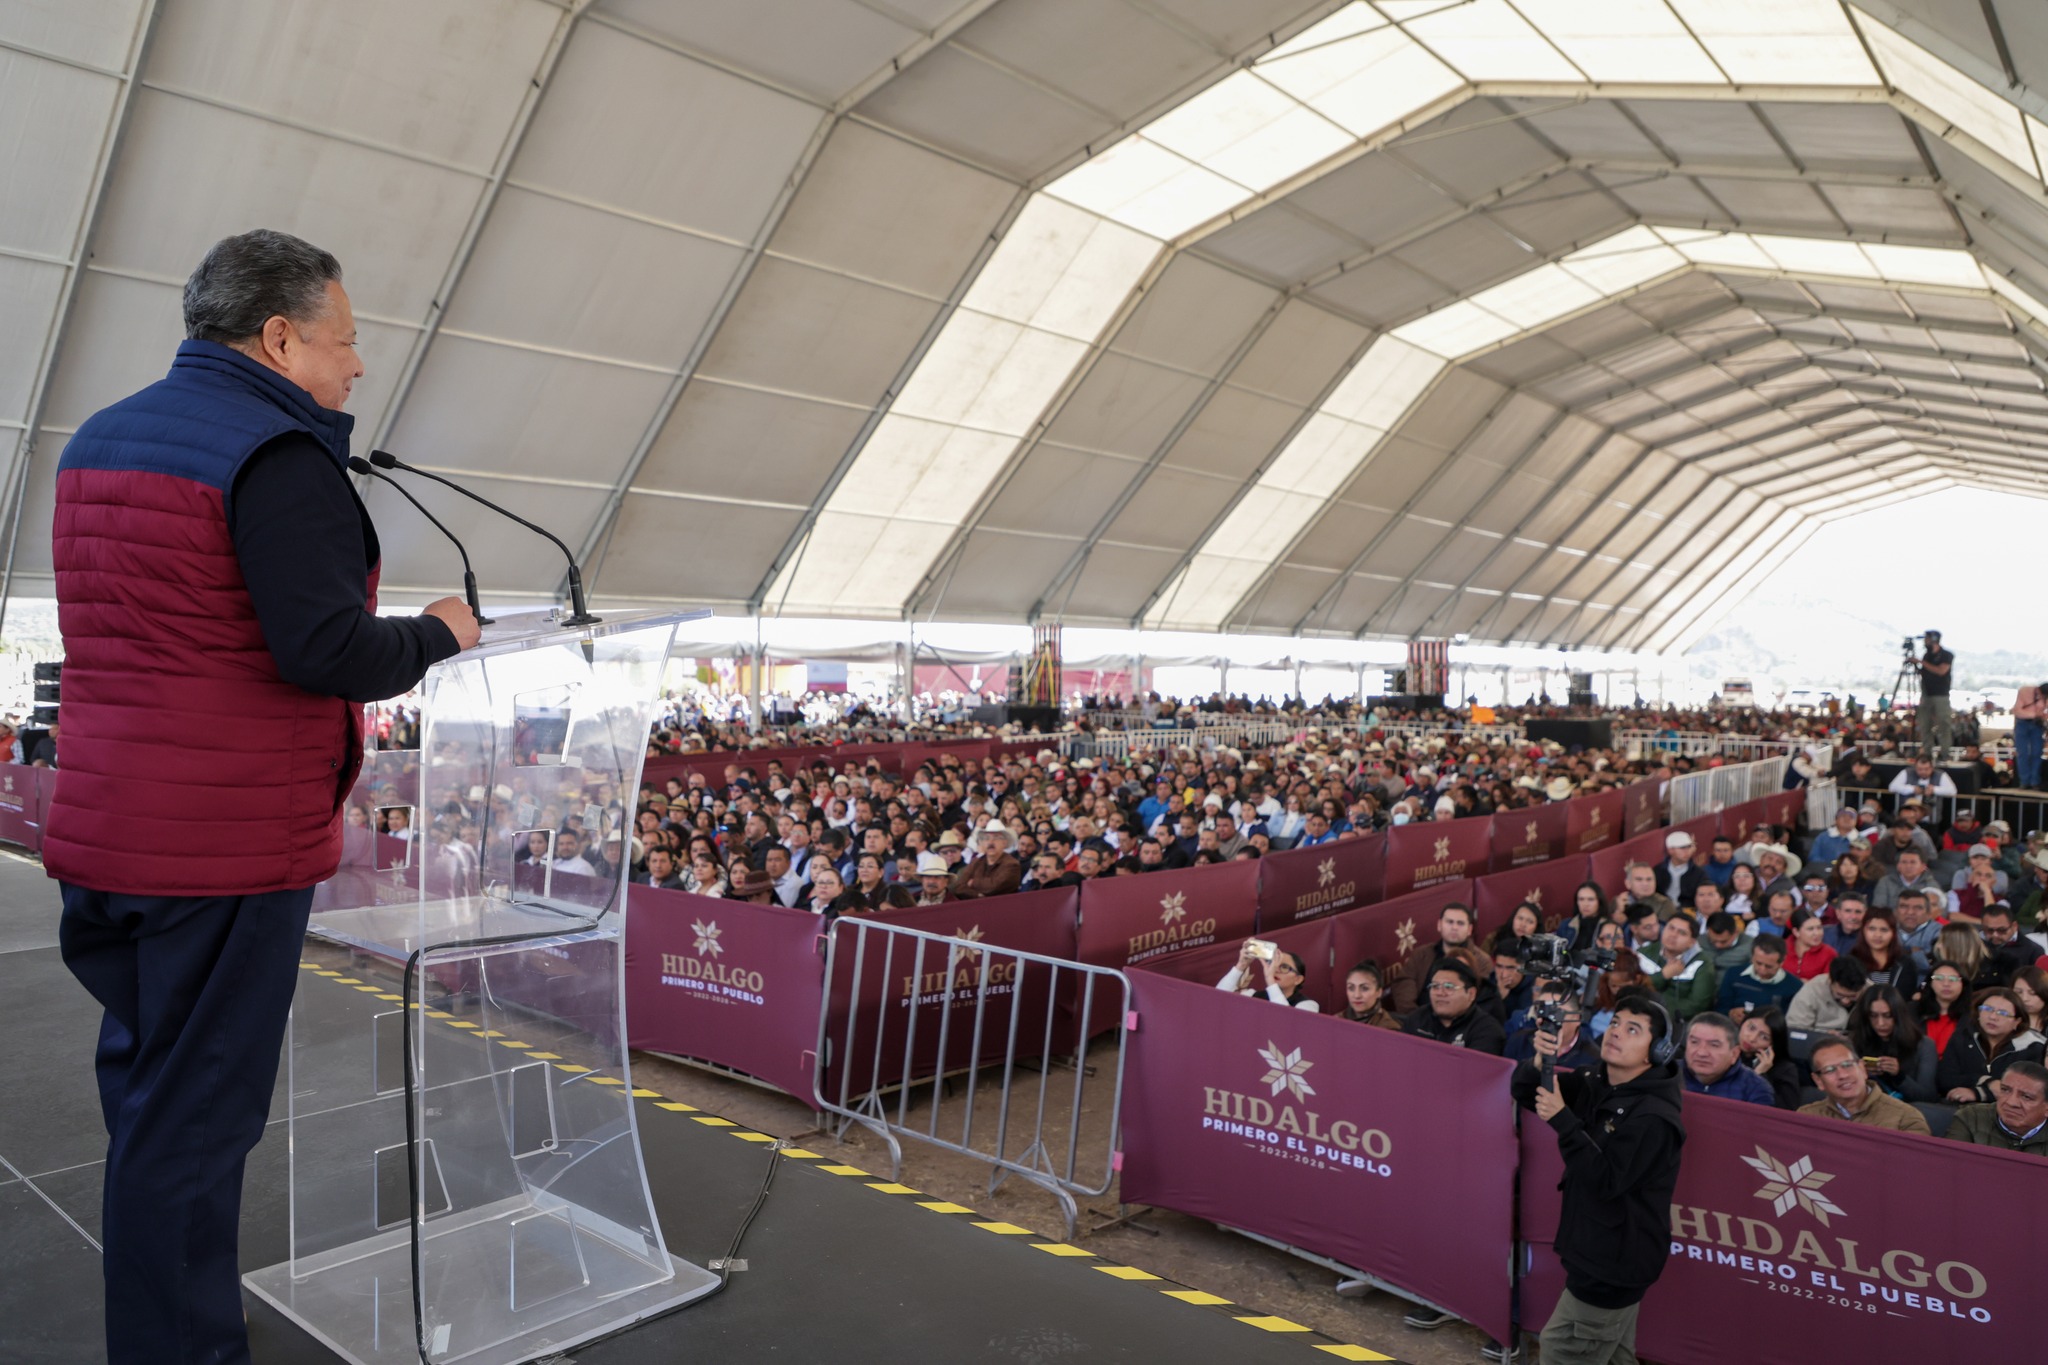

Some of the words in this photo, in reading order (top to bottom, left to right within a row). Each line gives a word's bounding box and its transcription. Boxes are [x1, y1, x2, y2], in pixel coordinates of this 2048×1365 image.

[1415, 859, 1466, 881] HIDALGO
[1296, 881, 1356, 911] HIDALGO
[1127, 945, 1168, 965] PRIMERO
[1169, 942, 1180, 951] EL
[1182, 935, 1215, 948] PUEBLO
[1128, 917, 1216, 955] HIDALGO
[661, 953, 764, 993] HIDALGO
[661, 975, 705, 991] PRIMERO
[707, 982, 720, 994] EL
[722, 986, 764, 1005] PUEBLO
[959, 989, 973, 999] EL
[1203, 1086, 1392, 1159] HIDALGO
[1202, 1116, 1280, 1144] PRIMERO
[1286, 1136, 1308, 1153] EL
[1315, 1144, 1392, 1177] PUEBLO
[1259, 1144, 1325, 1170] 2022-2028
[1669, 1203, 1988, 1299] HIDALGO
[1669, 1241, 1797, 1280] PRIMERO
[1810, 1270, 1846, 1292] EL
[1858, 1281, 1992, 1324] PUEBLO
[1767, 1280, 1878, 1315] 2022-2028
